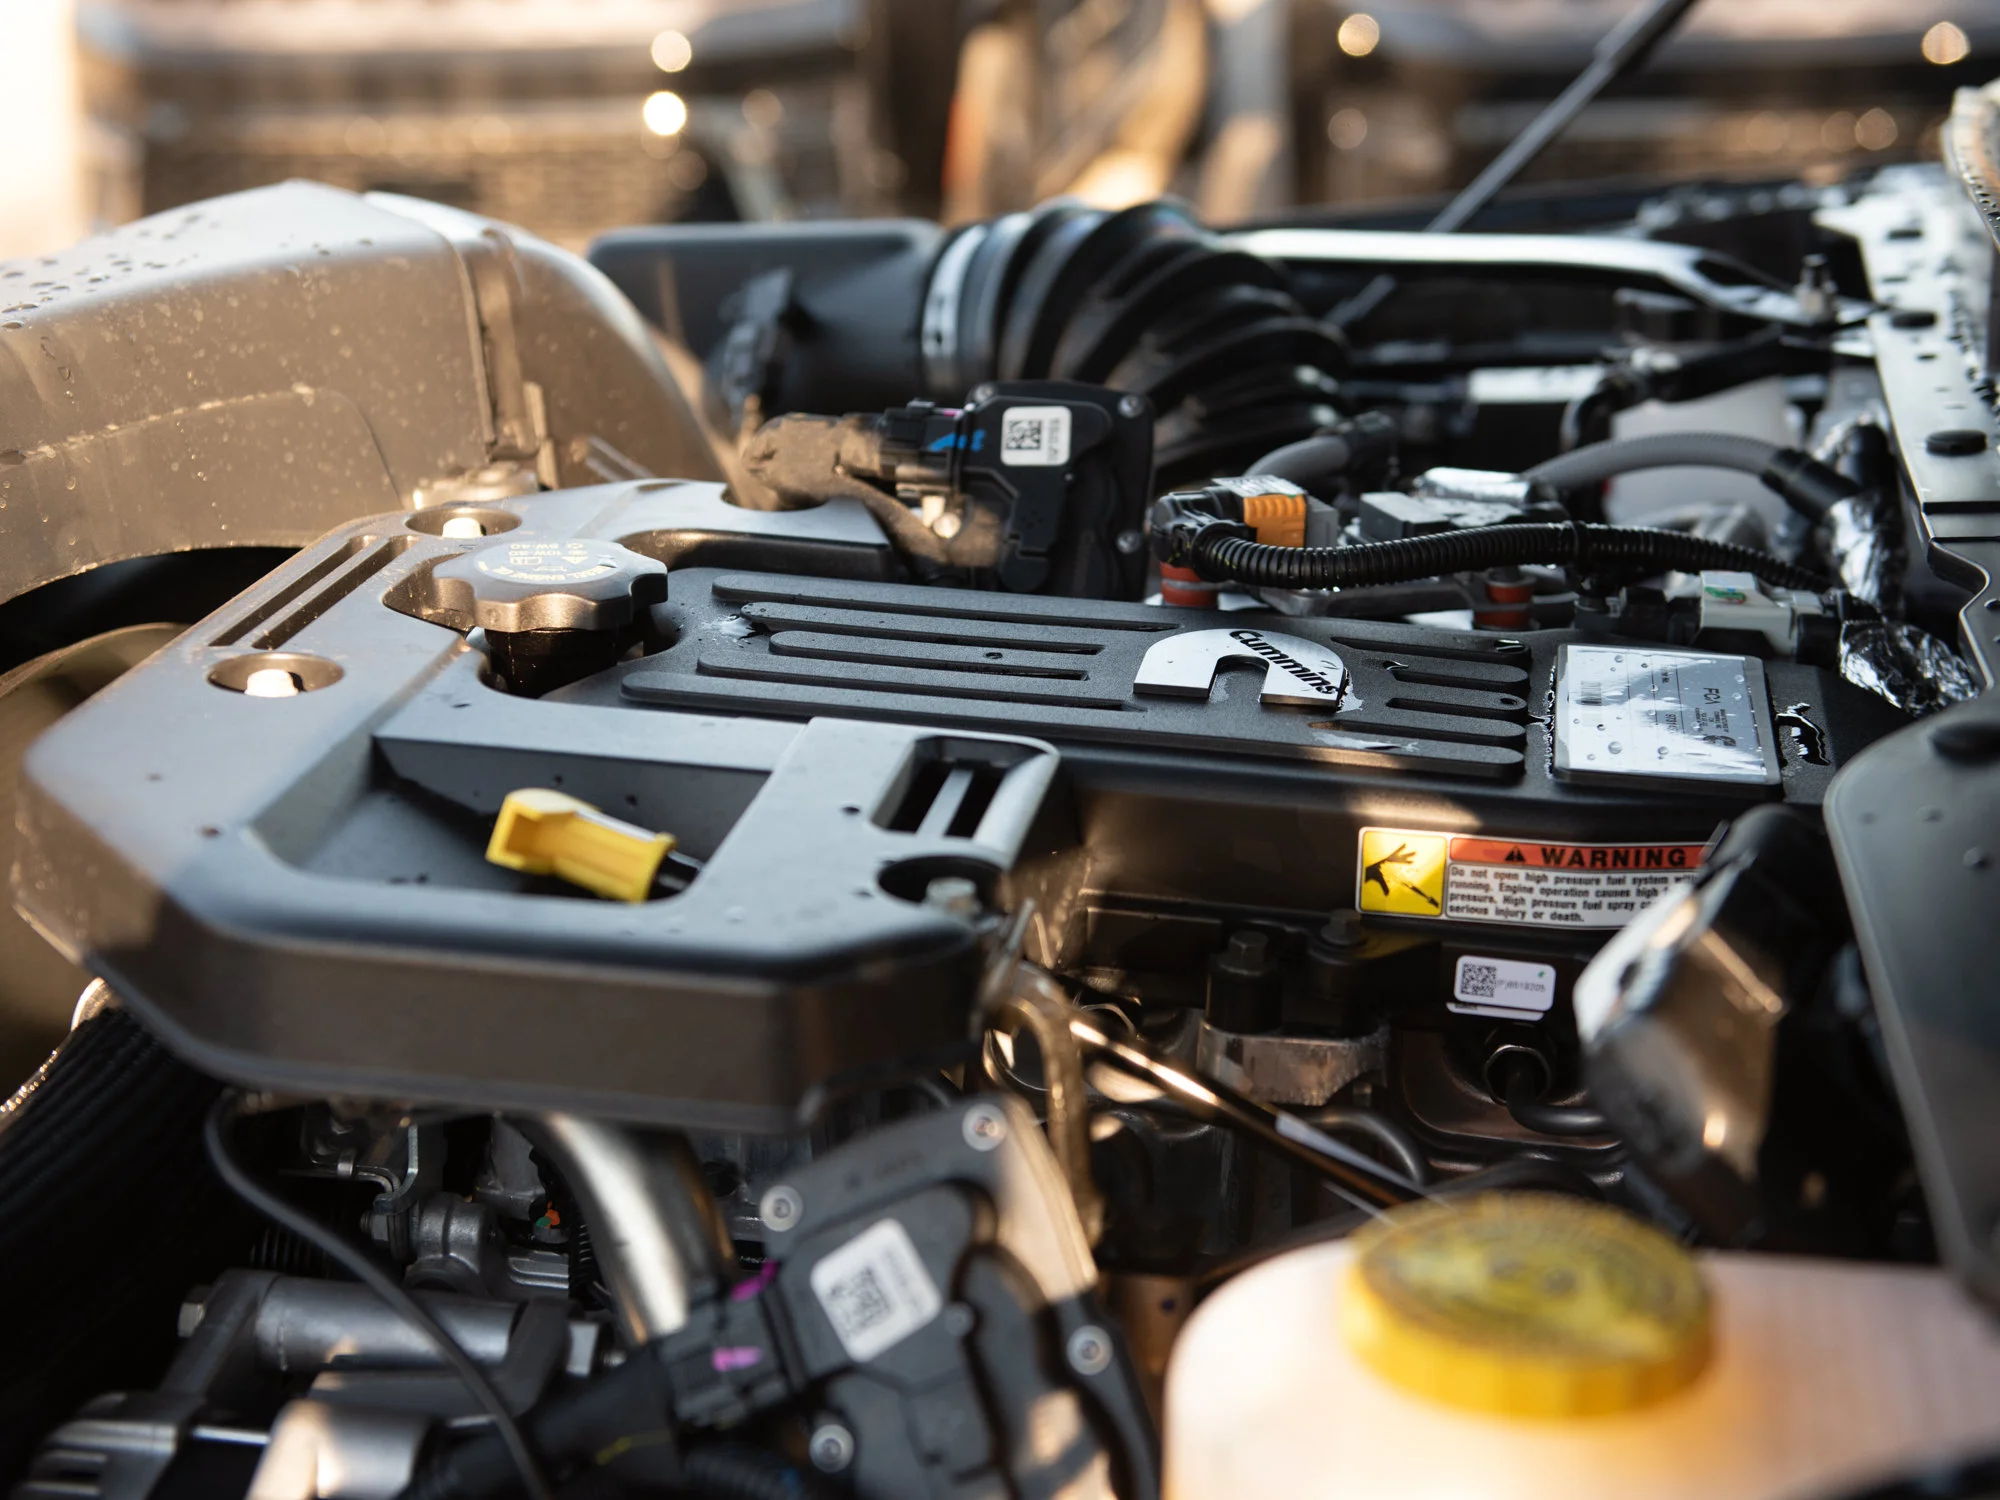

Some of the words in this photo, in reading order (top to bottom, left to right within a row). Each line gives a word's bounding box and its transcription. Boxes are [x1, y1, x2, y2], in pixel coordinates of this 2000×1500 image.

[568, 564, 612, 579] IESEL
[1229, 630, 1340, 695] Cummins
[1703, 687, 1721, 705] FCA
[1541, 847, 1687, 867] WARNING
[1451, 866, 1465, 877] Do
[1471, 868, 1488, 879] not
[1493, 871, 1519, 883] open
[1525, 871, 1548, 885] high
[1554, 874, 1600, 886] pressure
[1606, 874, 1626, 885] fuel
[1631, 875, 1669, 887] system
[1450, 880, 1493, 893] running.
[1499, 881, 1533, 895] Engine
[1539, 885, 1589, 898] operation
[1595, 888, 1631, 898] causes
[1636, 887, 1658, 899] high
[1450, 892, 1497, 905] pressure.
[1503, 895, 1526, 907] High
[1531, 898, 1577, 910] pressure
[1582, 900, 1602, 910] fuel
[1607, 901, 1634, 912] spray
[1449, 904, 1488, 916] serious
[1495, 906, 1526, 920] injury
[1532, 911, 1544, 920] or
[1550, 910, 1585, 923] death.
